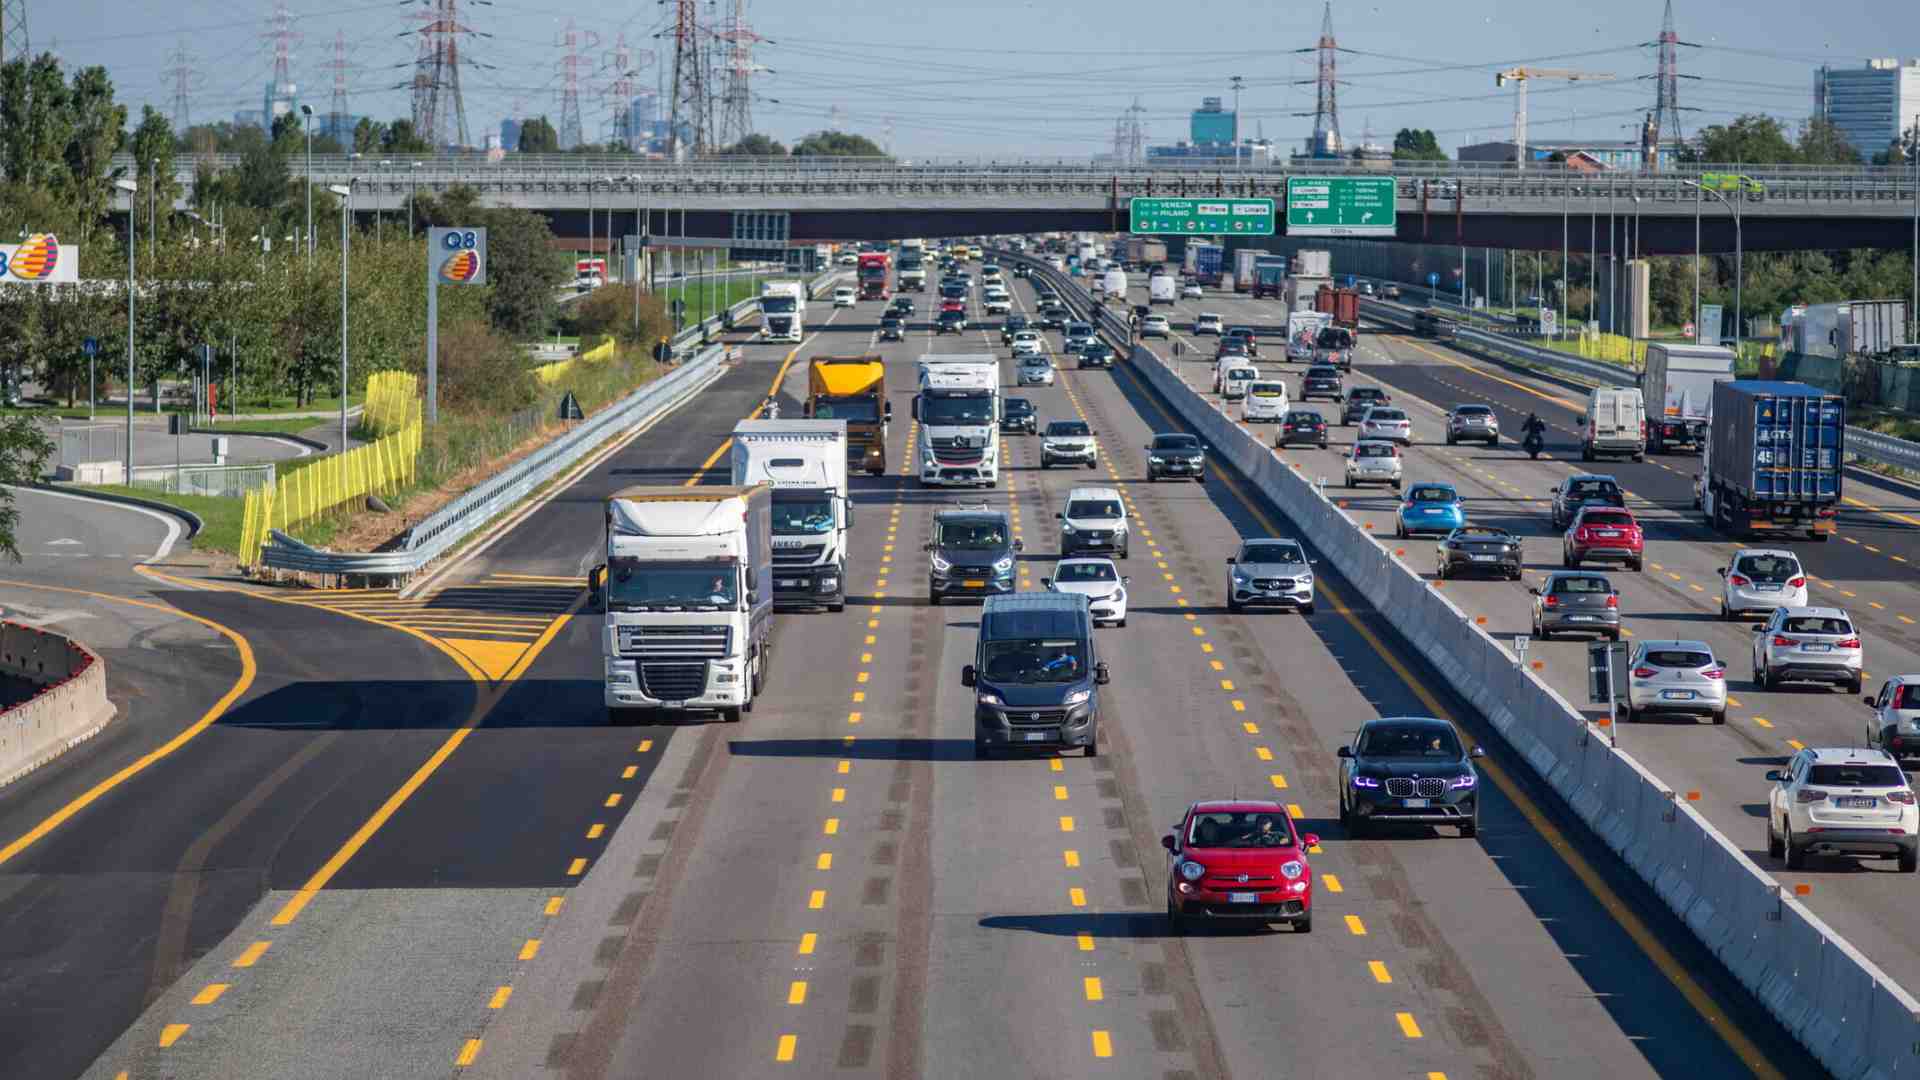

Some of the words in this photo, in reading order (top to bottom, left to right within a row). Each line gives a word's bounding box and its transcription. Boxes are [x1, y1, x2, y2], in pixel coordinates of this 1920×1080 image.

[447, 231, 475, 249] Q8
[1770, 430, 1793, 440] GTS
[1757, 450, 1774, 464] 45
[773, 540, 802, 549] IVECO
